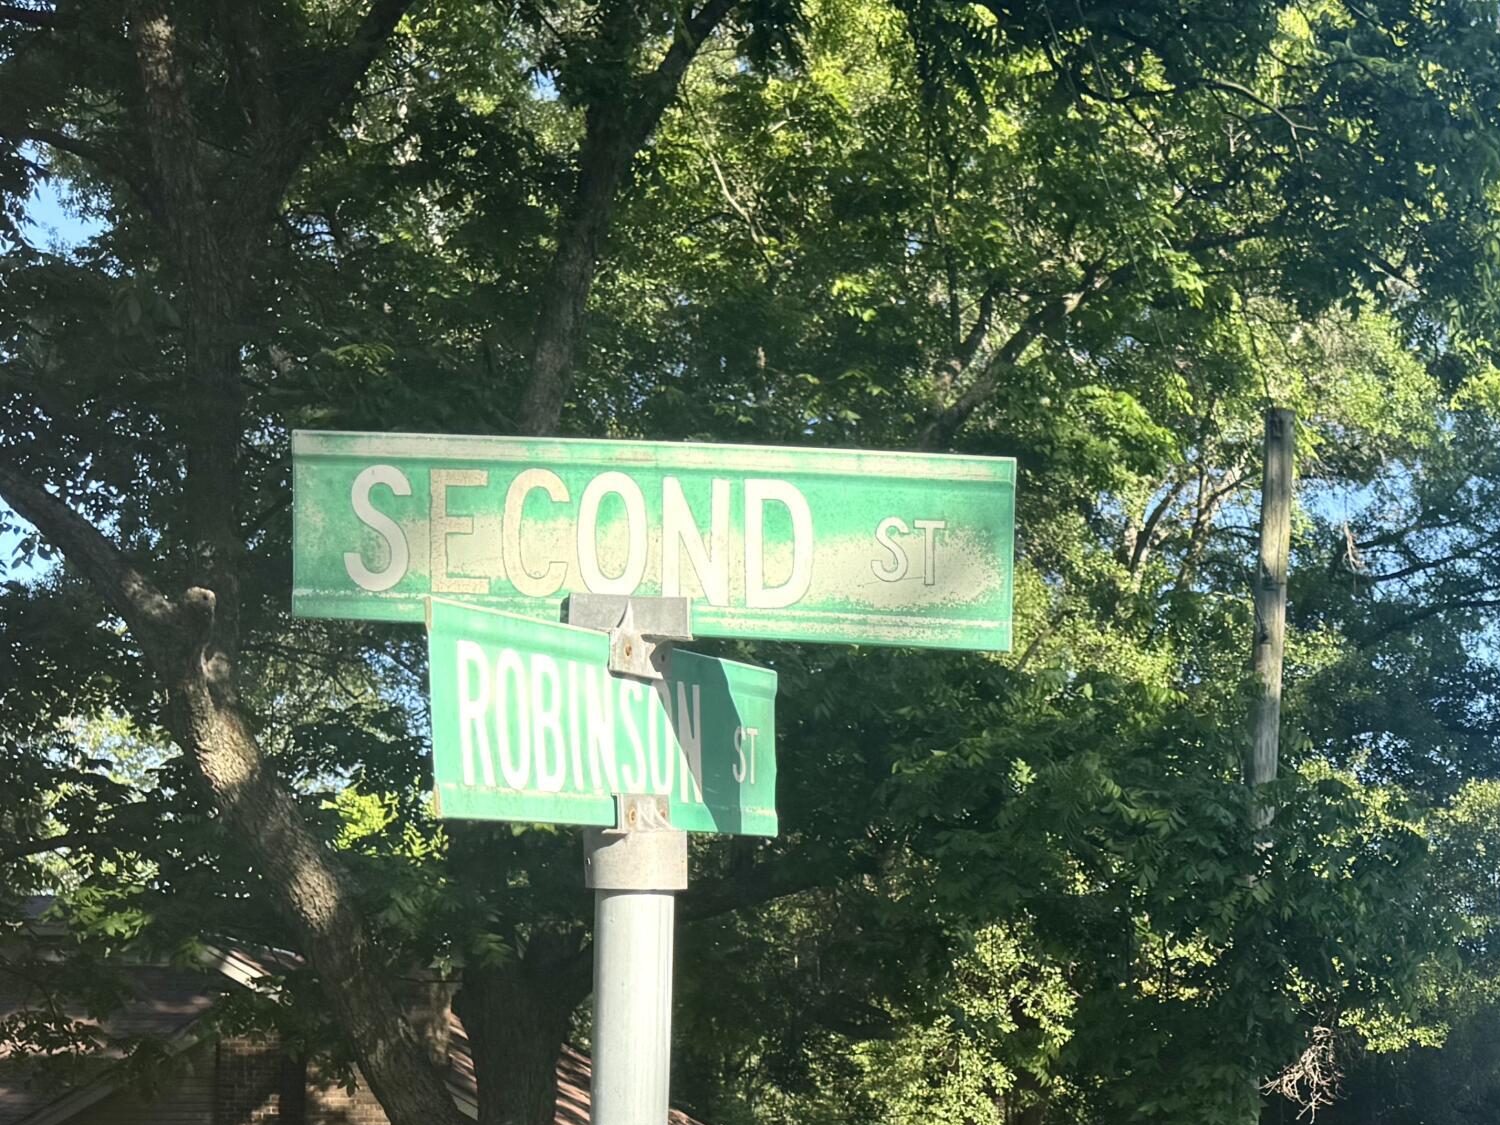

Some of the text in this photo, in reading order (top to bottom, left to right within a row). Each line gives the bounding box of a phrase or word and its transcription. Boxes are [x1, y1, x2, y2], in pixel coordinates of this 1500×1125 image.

[343, 463, 947, 609] SECOND ST
[456, 640, 759, 804] ROBINSON ST
